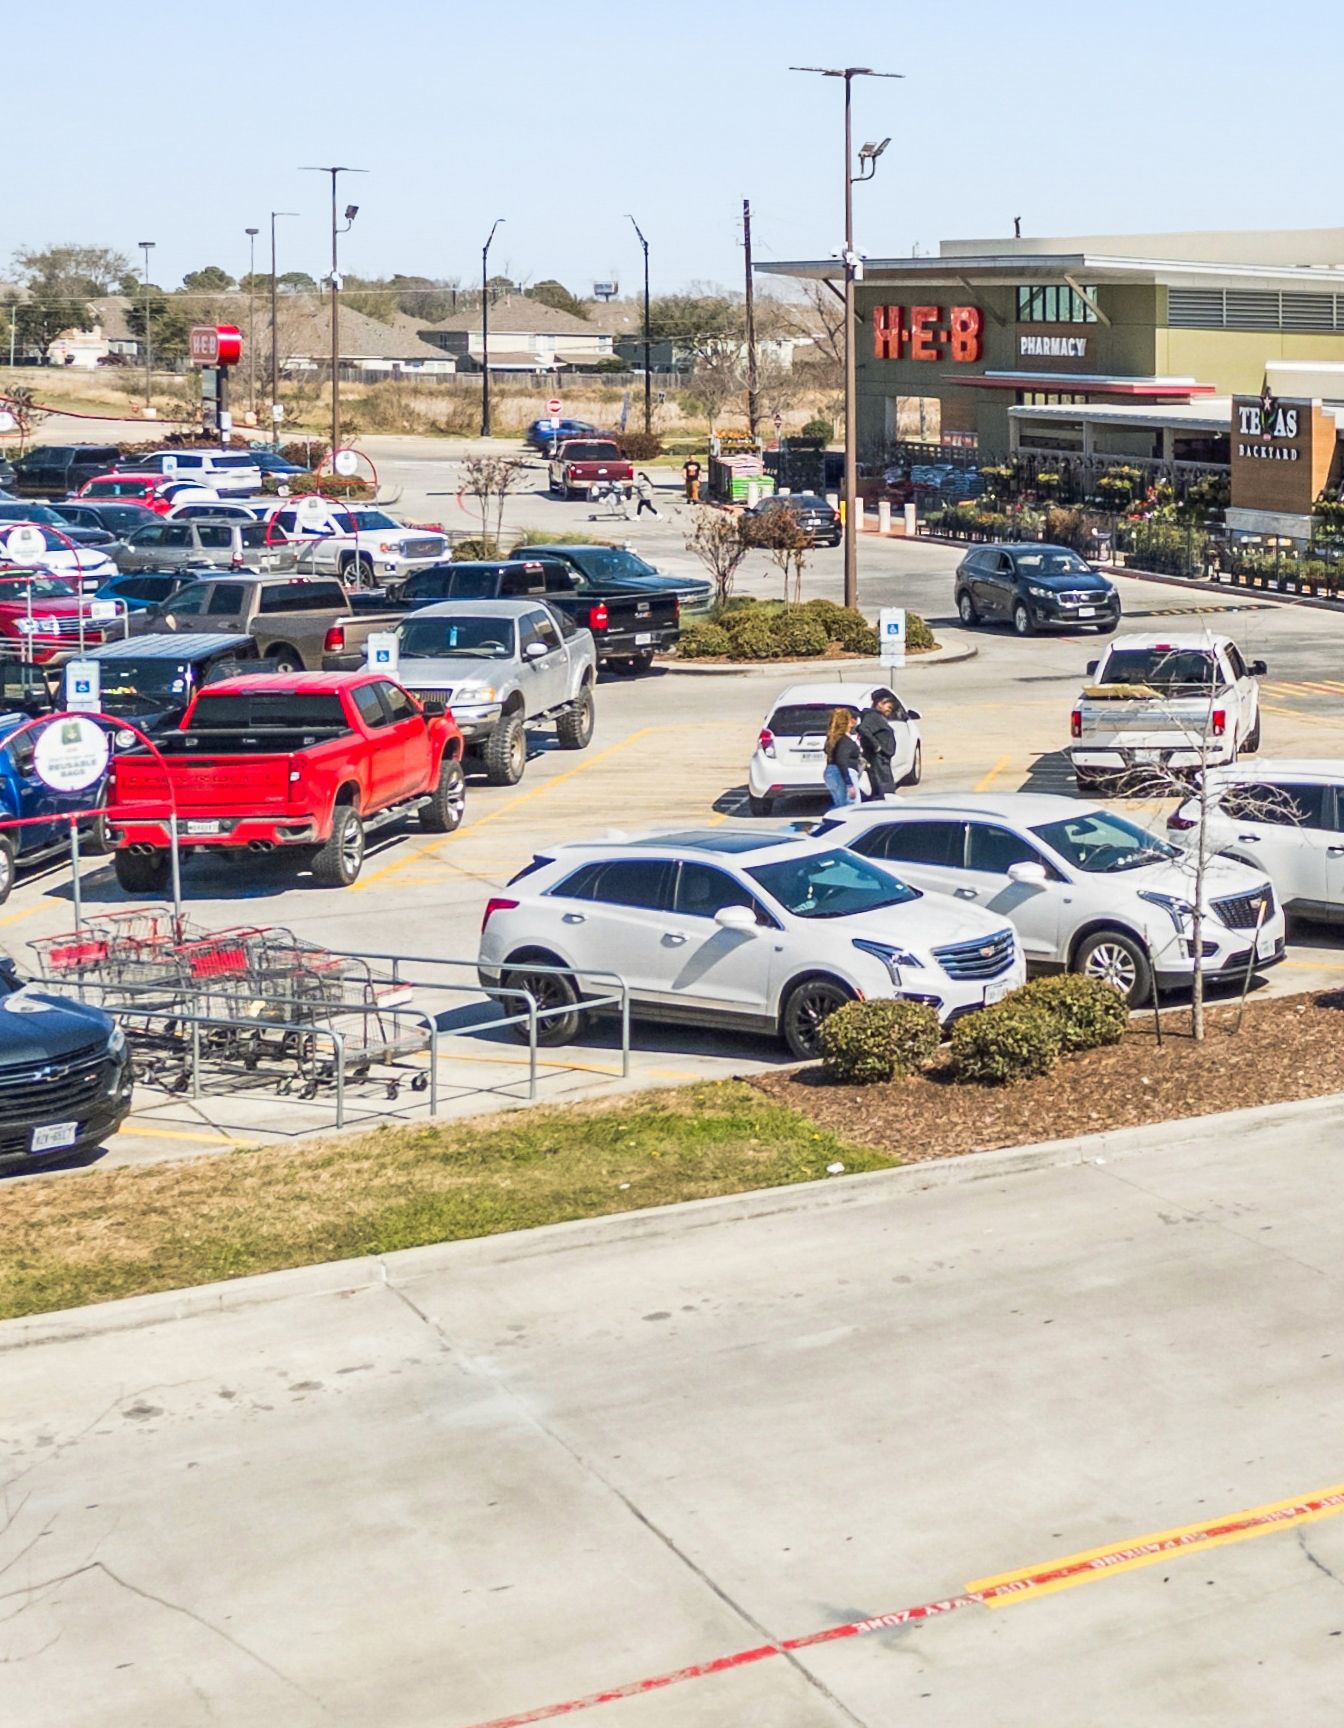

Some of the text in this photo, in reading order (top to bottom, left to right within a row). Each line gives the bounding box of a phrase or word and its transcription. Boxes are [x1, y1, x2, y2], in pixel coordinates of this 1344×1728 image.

[1020, 336, 1087, 357] PHARMACY
[1239, 443, 1298, 461] BACKYARD
[47, 759, 97, 771] REUSABLE
[60, 769, 87, 778] BAGS
[855, 1610, 915, 1634] ZONE
